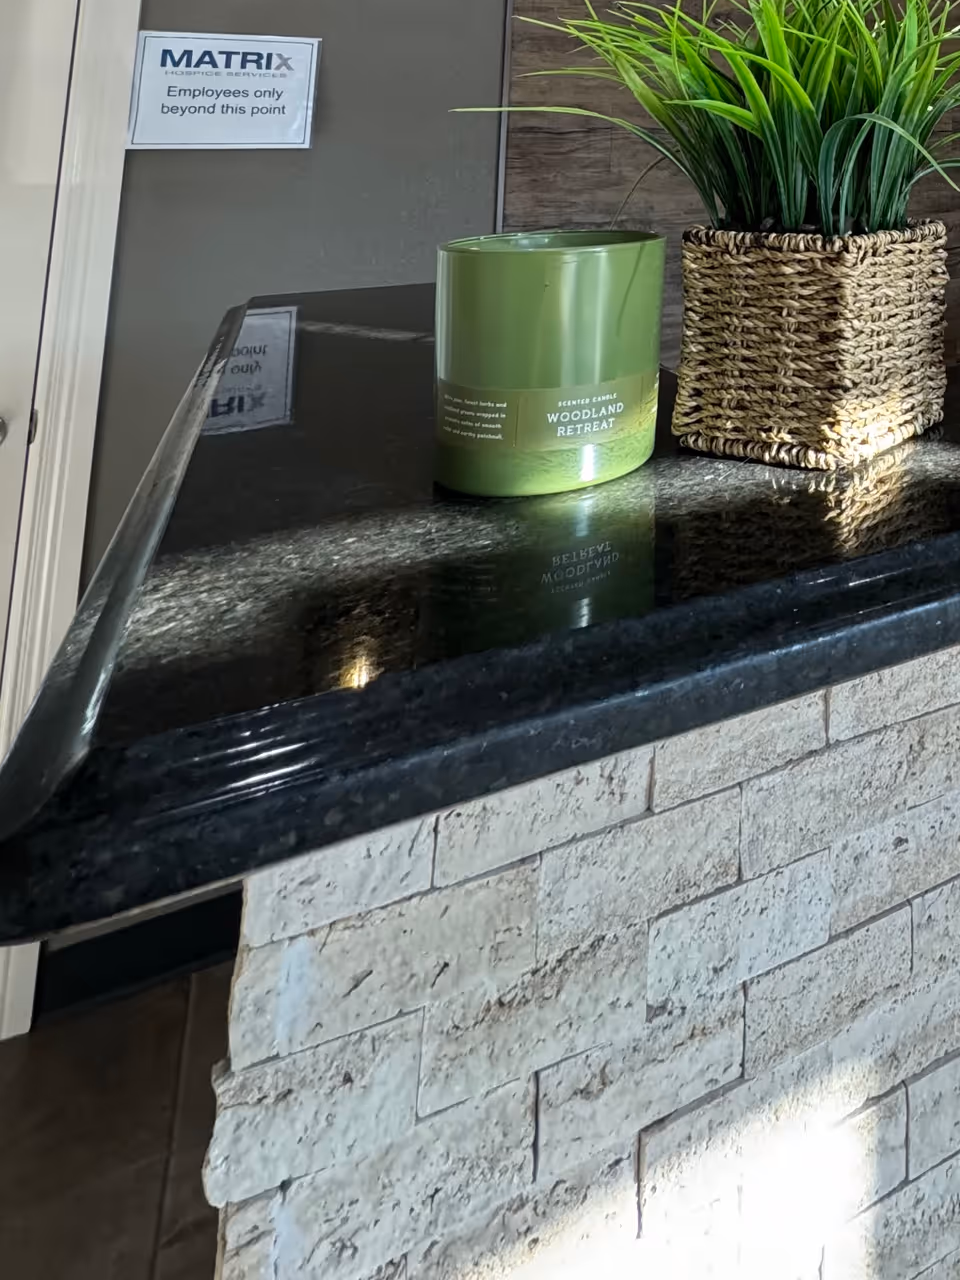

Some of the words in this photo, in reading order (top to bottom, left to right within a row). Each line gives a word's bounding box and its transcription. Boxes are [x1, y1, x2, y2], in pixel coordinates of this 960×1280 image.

[160, 49, 294, 71] MATRIX
[167, 85, 250, 100] Employees
[254, 88, 284, 101] only
[161, 103, 216, 117] beyond
[221, 104, 246, 115] this
[251, 104, 286, 117] point
[558, 398, 590, 407] SCENTED
[592, 393, 617, 403] CANDLE
[547, 402, 624, 423] WOODLAND
[557, 418, 615, 436] RETREAT
